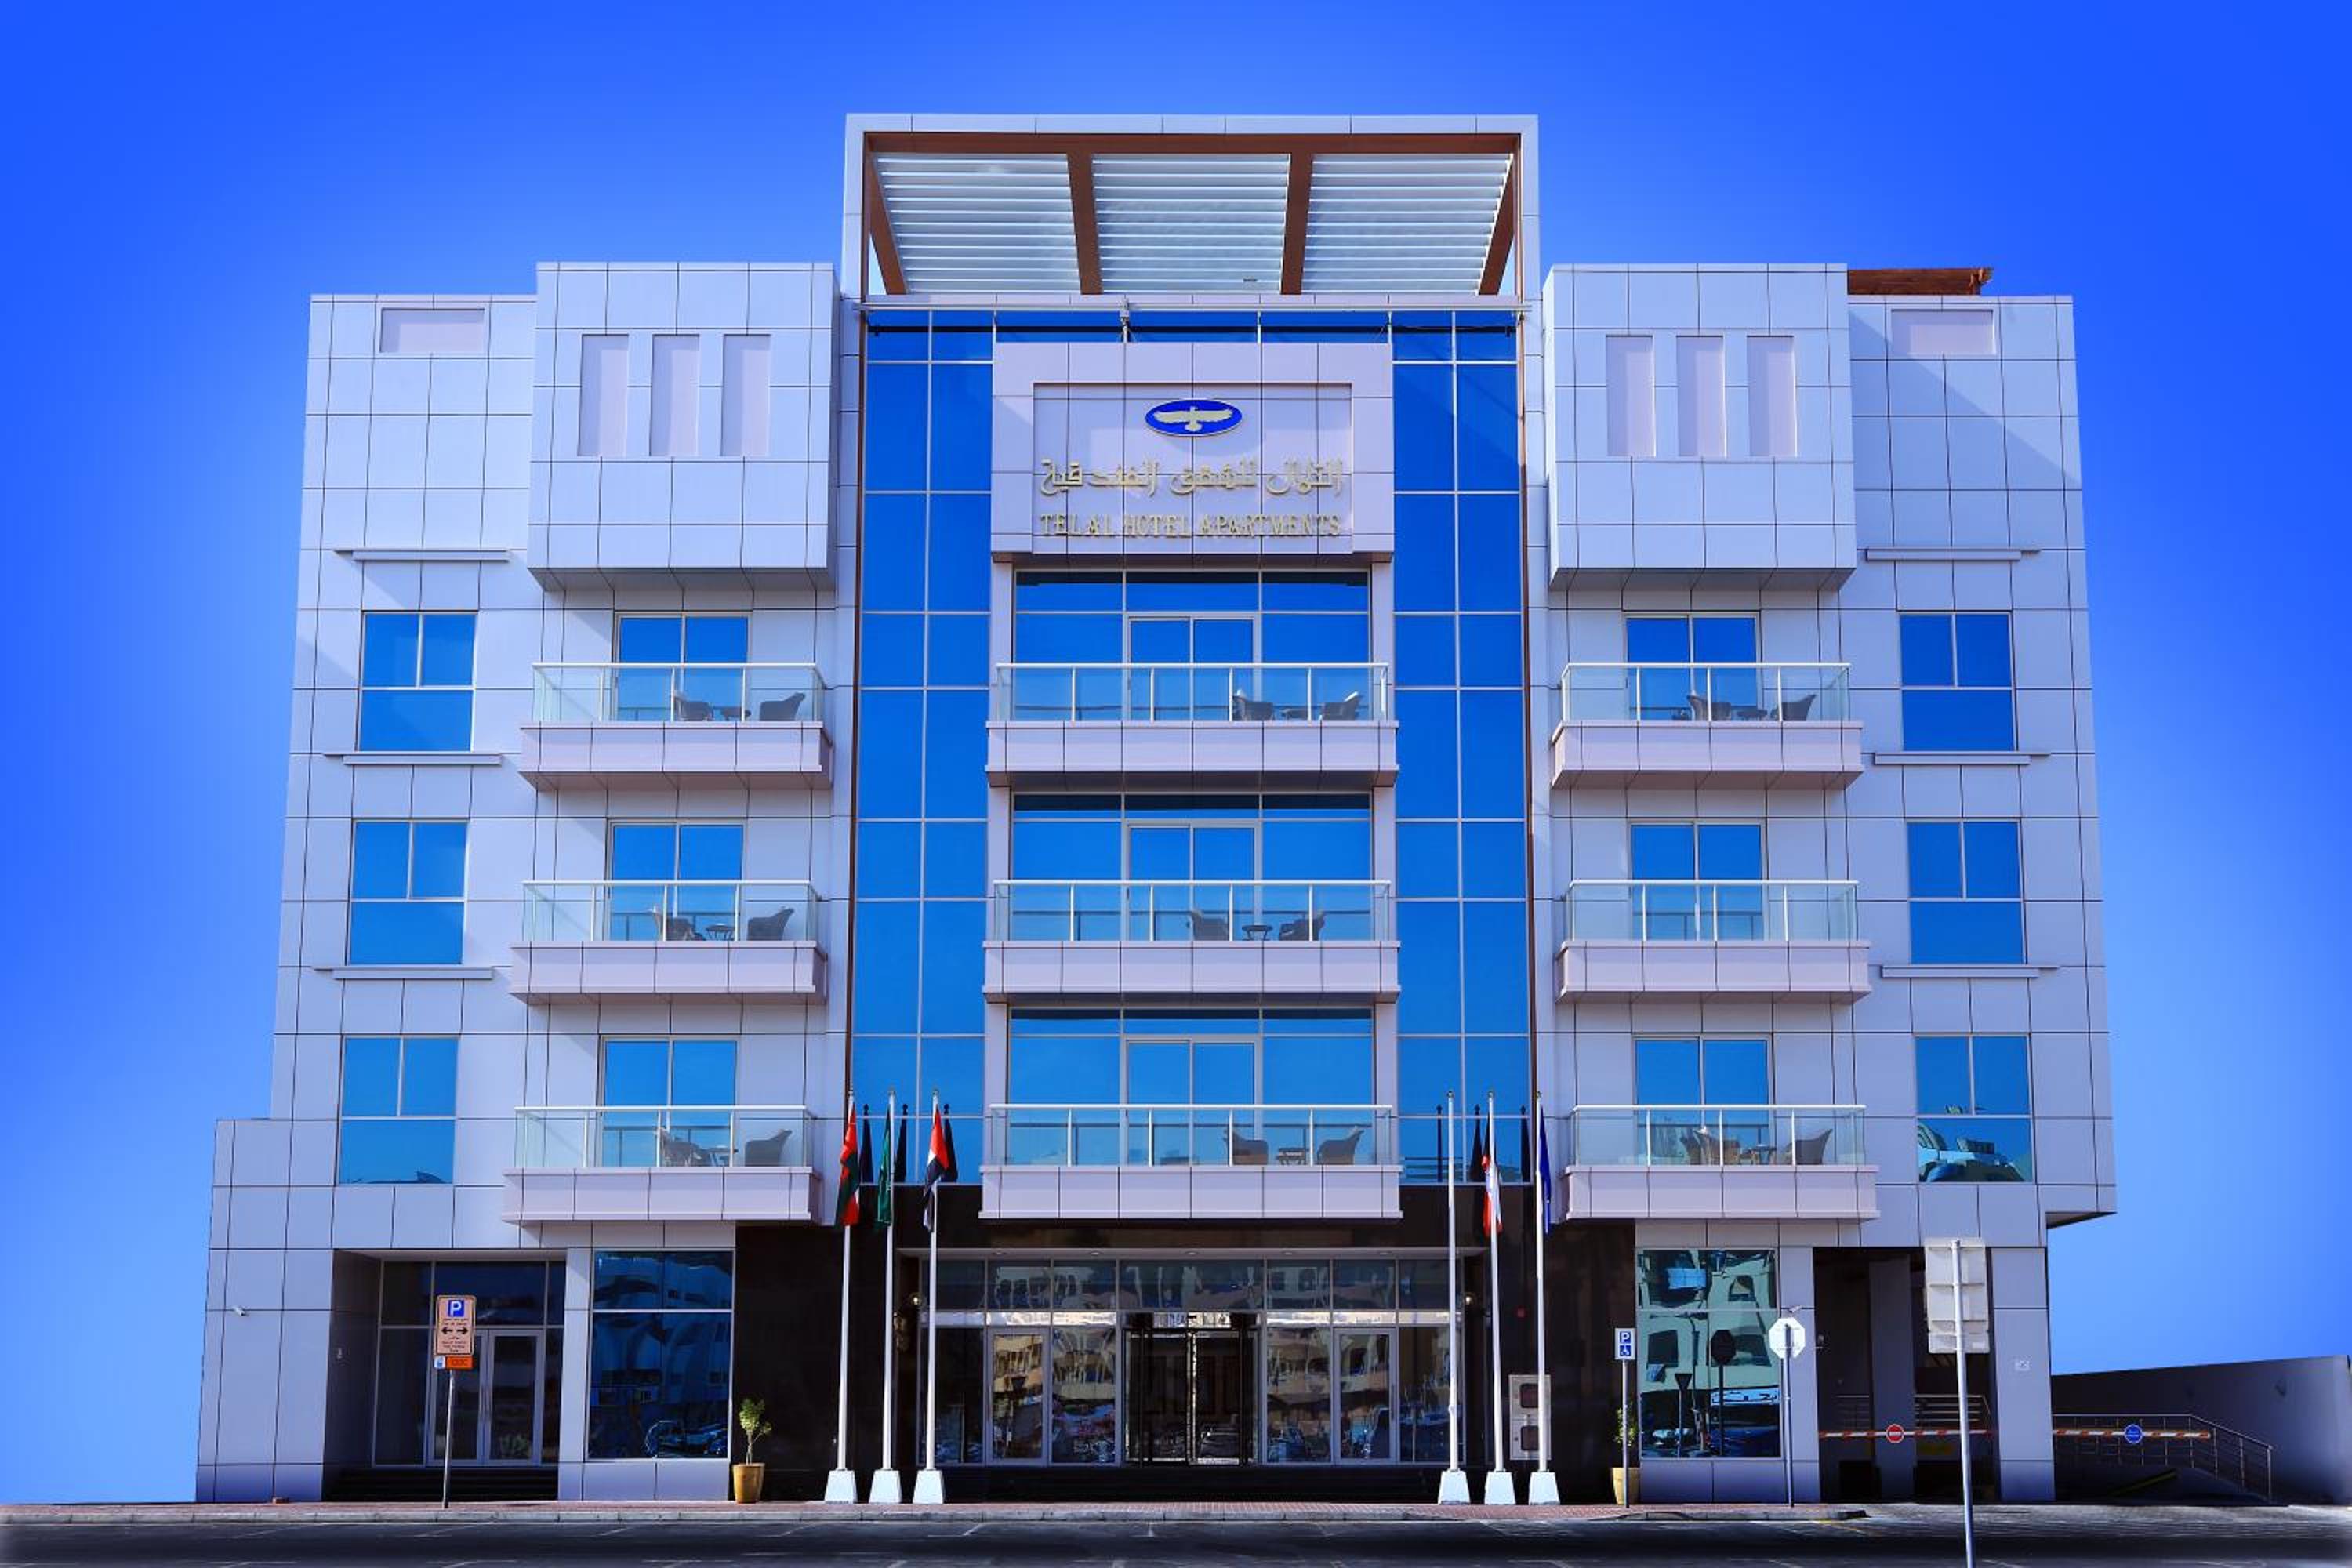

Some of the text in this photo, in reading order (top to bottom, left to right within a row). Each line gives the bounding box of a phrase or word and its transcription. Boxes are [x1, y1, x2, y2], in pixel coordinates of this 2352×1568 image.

[1041, 455, 1159, 497] الفندقية
[1040, 514, 1340, 538] TELAL HOTEL APARTMENTS
[450, 1301, 462, 1316] P
[1621, 1332, 1630, 1343] P
